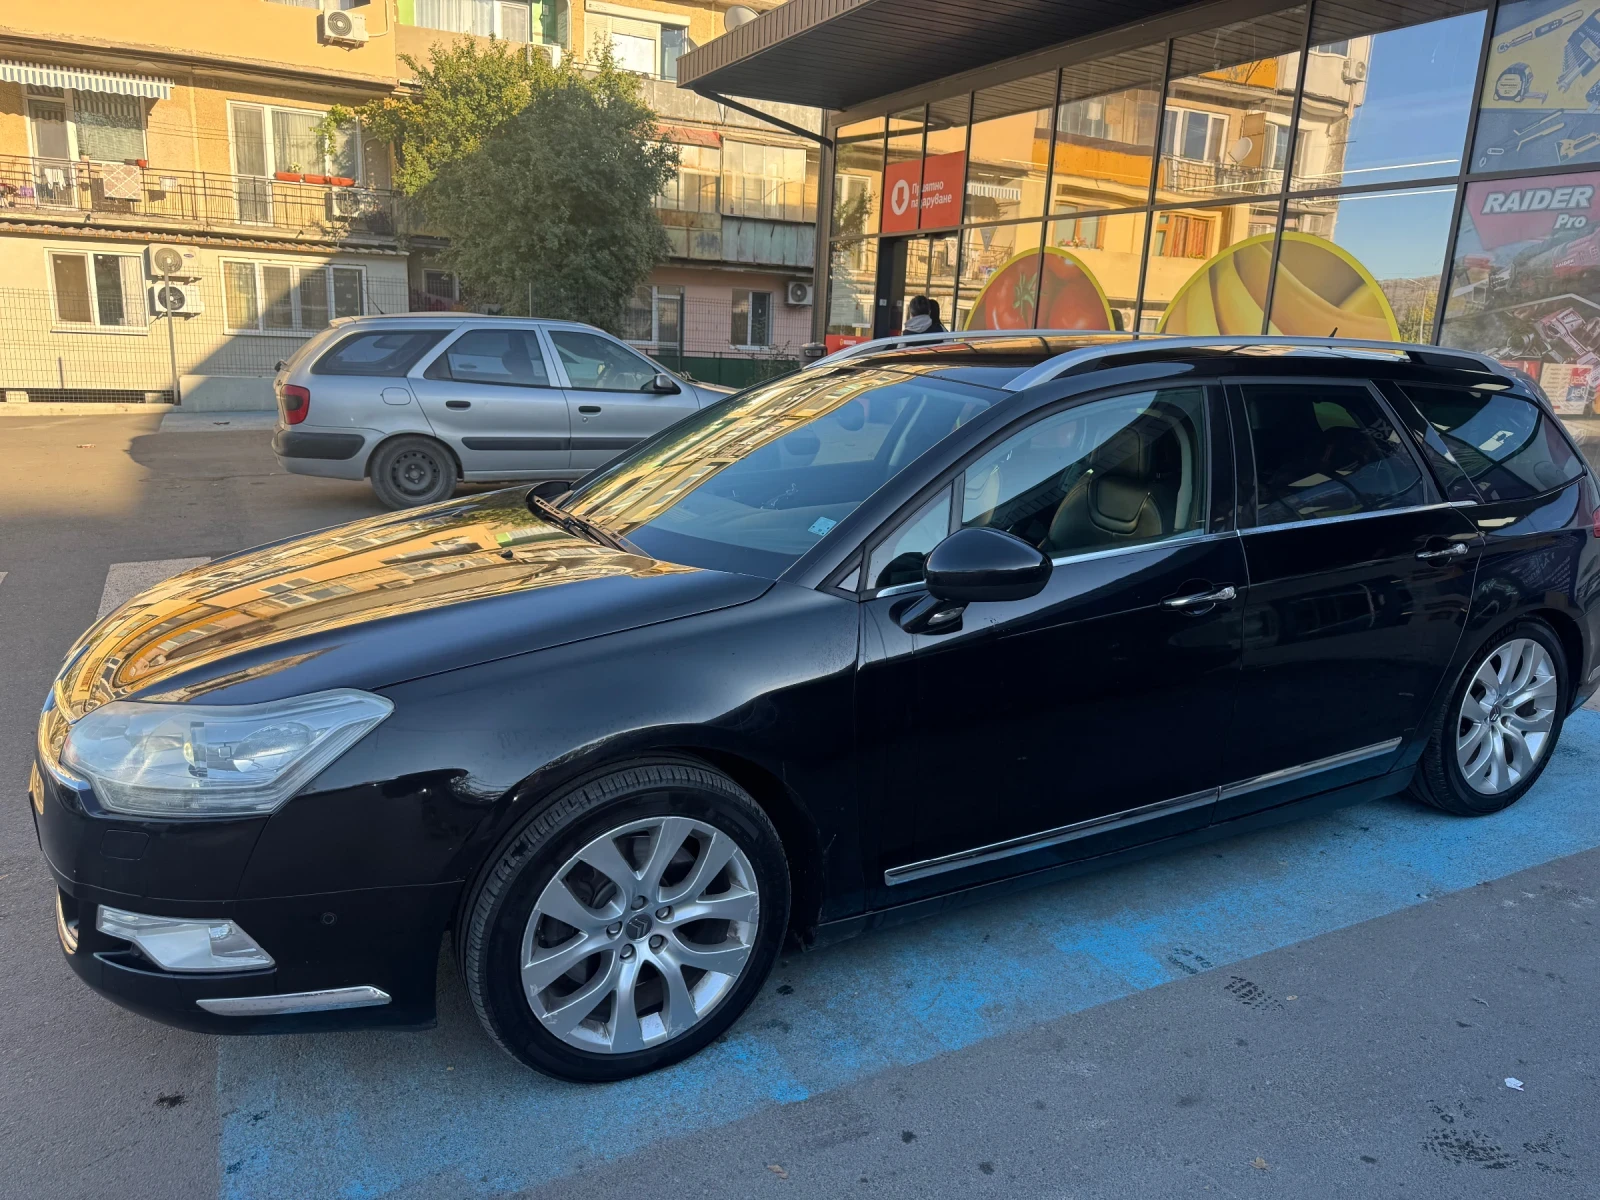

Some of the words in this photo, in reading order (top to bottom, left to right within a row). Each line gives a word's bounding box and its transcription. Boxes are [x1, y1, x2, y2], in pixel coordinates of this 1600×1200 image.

[911, 192, 952, 209] пааруване
[1481, 185, 1594, 214] RAIDER
[1553, 213, 1587, 229] Pro
